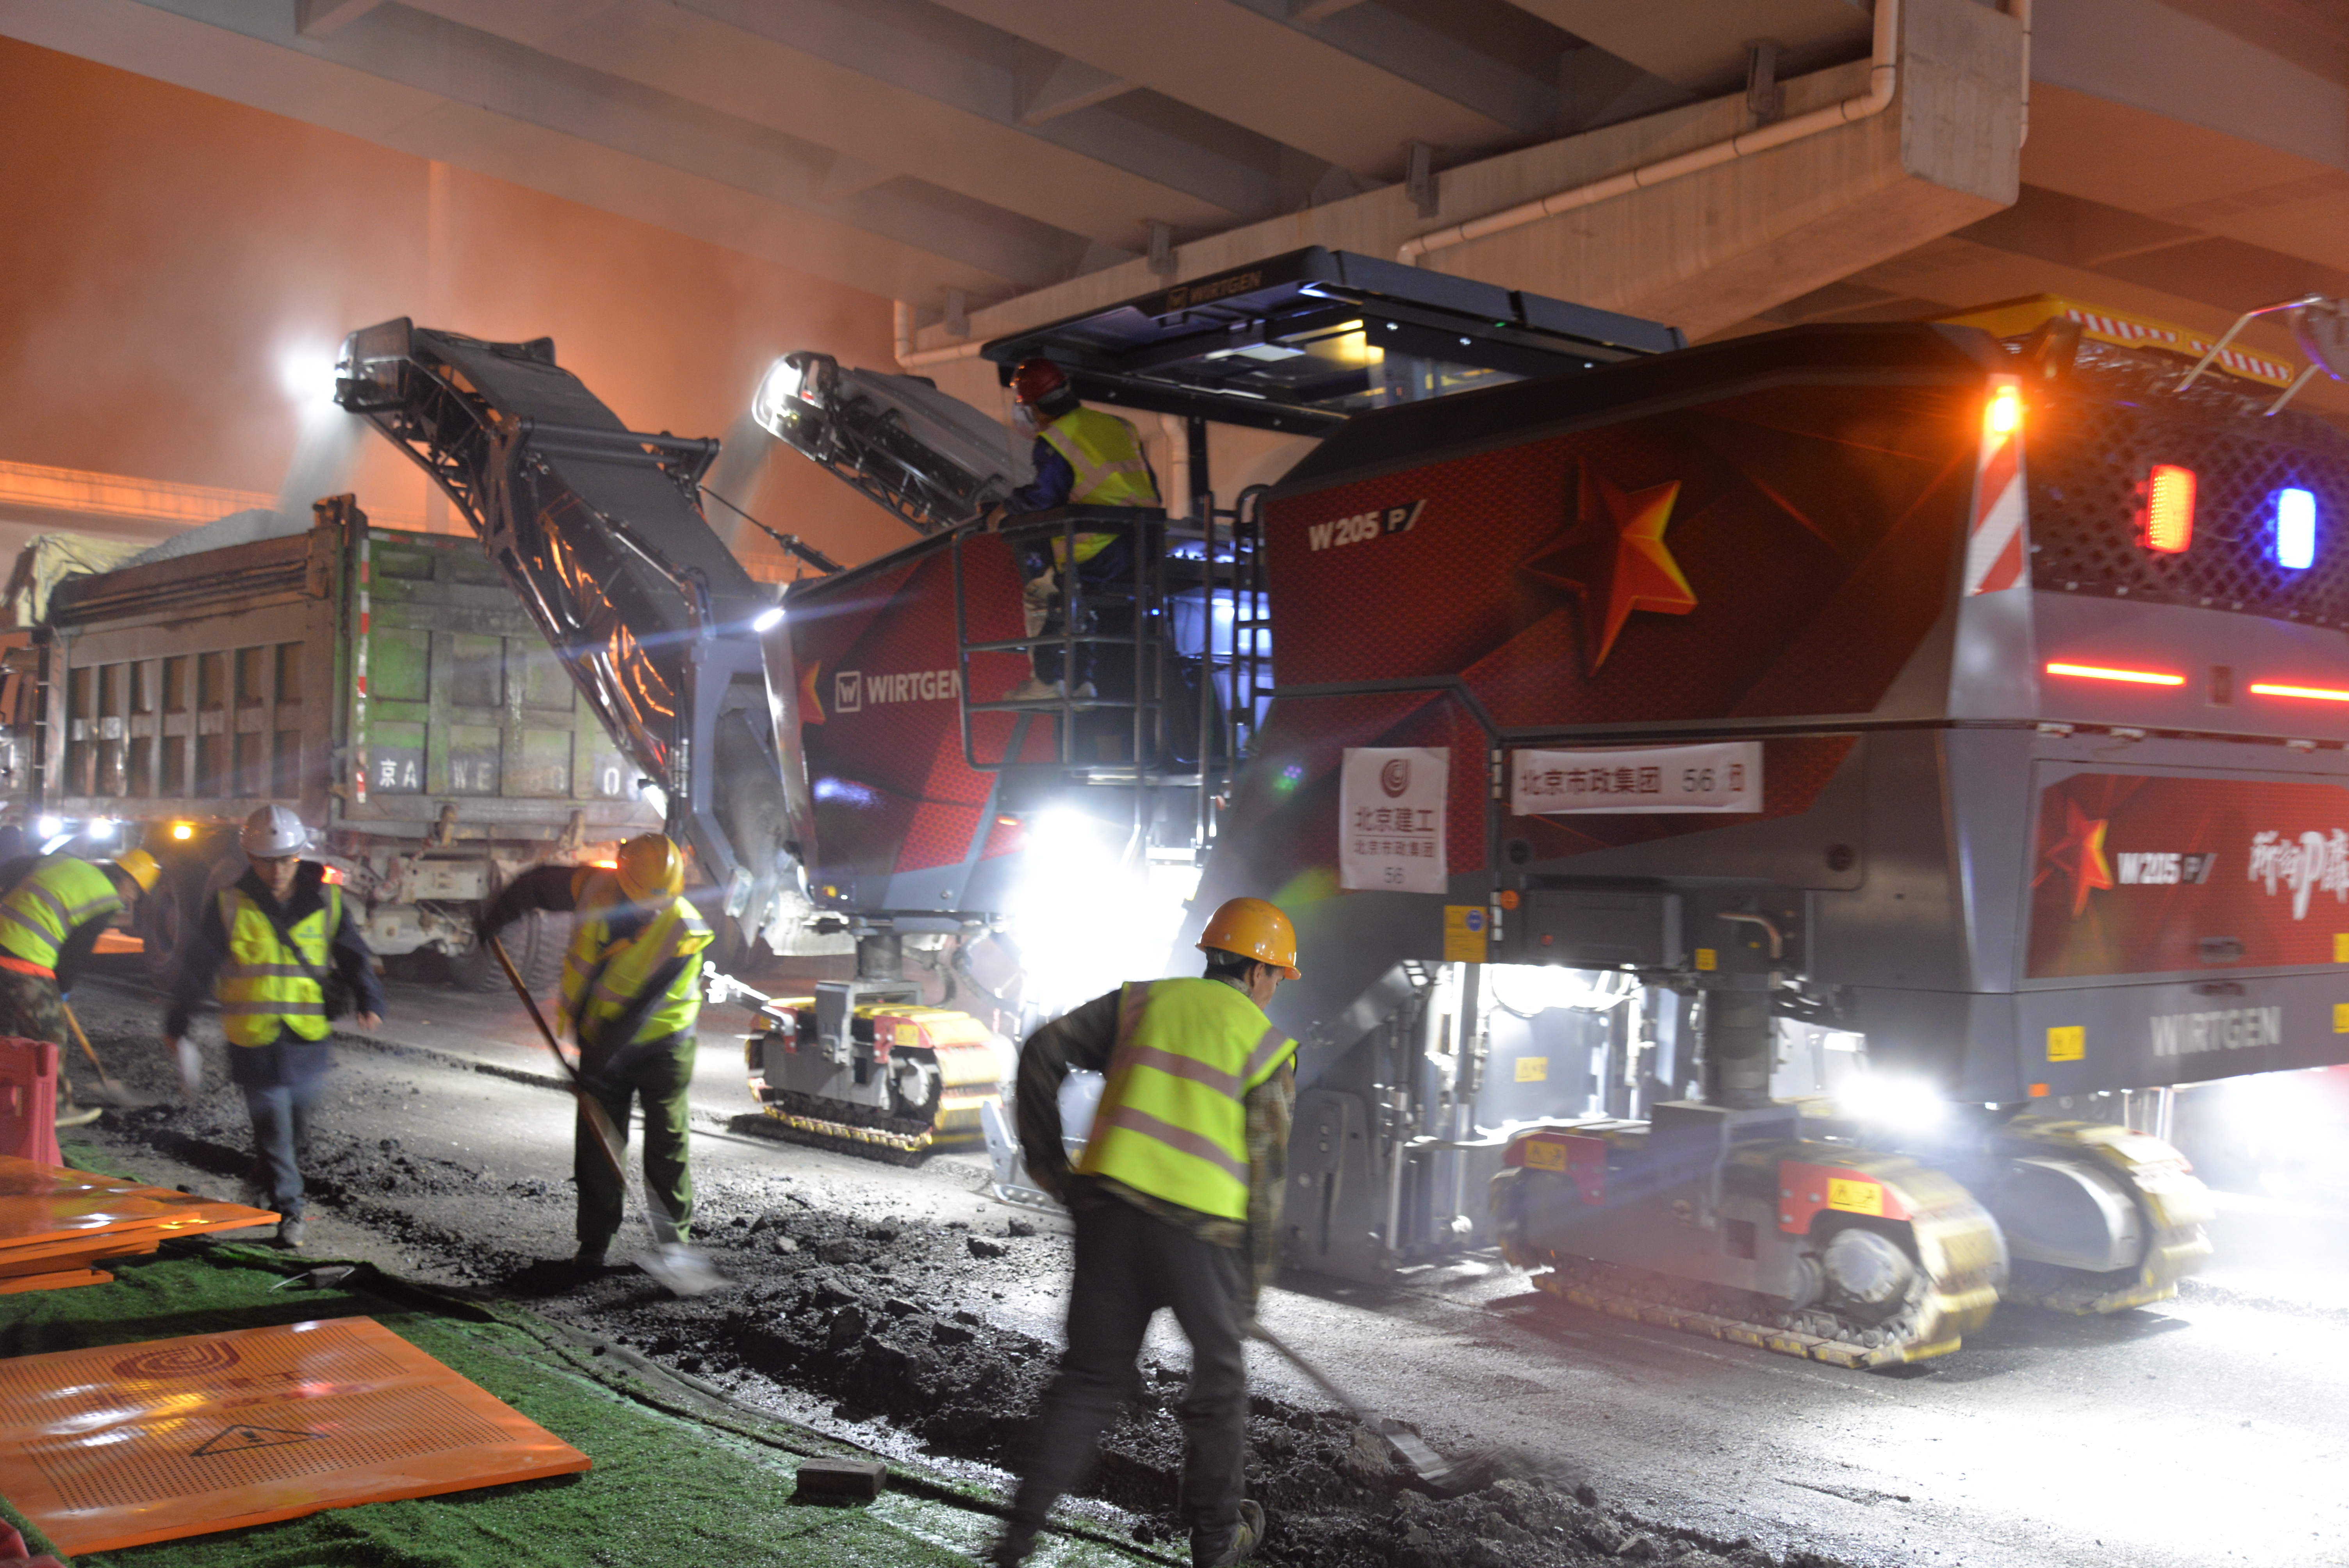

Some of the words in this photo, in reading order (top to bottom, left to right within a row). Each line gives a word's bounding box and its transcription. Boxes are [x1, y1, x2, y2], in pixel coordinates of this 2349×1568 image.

[1308, 511, 1379, 551] W205
[1520, 766, 1663, 795] 北京市政集团
[1682, 768, 1715, 792] 56
[1355, 806, 1435, 832] 北京建工
[1384, 866, 1404, 884] 56
[2117, 852, 2183, 884] W205
[2150, 1007, 2281, 1056] WIRTGEN
